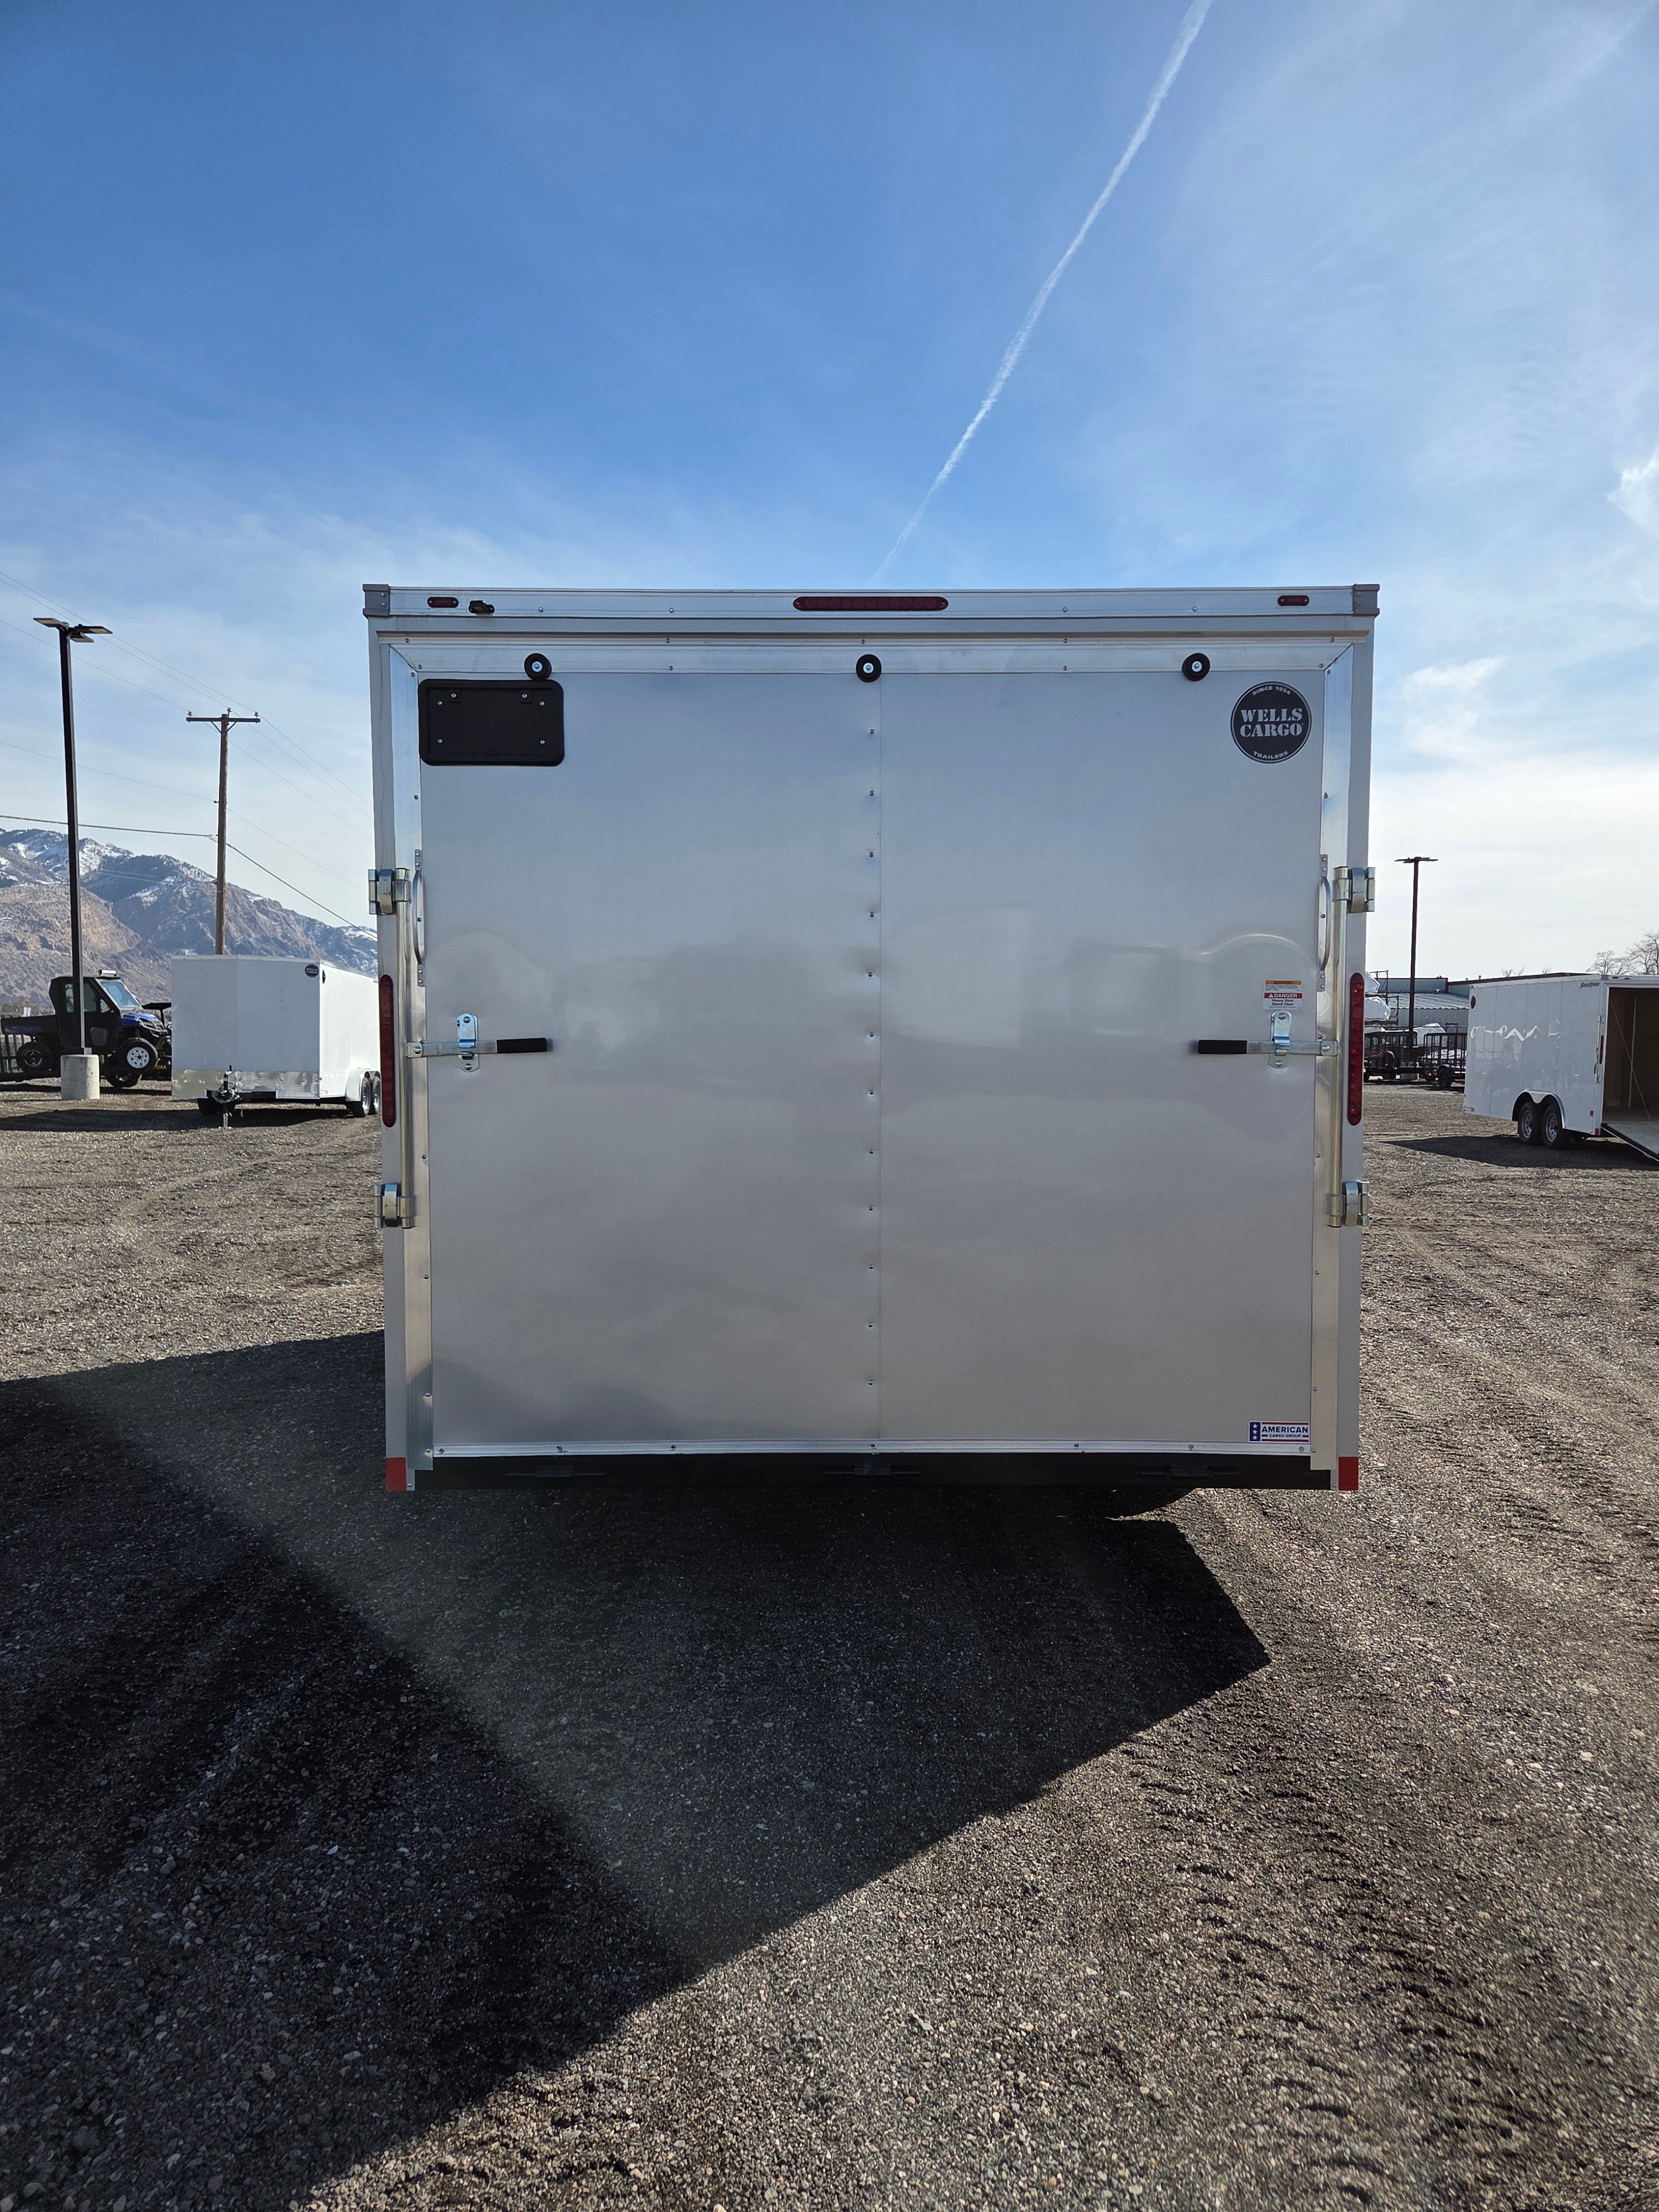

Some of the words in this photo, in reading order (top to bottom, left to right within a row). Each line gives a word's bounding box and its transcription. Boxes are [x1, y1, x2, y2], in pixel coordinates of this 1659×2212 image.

[1252, 686, 1273, 696] SINCE
[1275, 686, 1291, 695] 1954
[1240, 708, 1303, 722] WELLS
[1240, 723, 1303, 737] CARGO
[1253, 751, 1288, 759] TRAILERS
